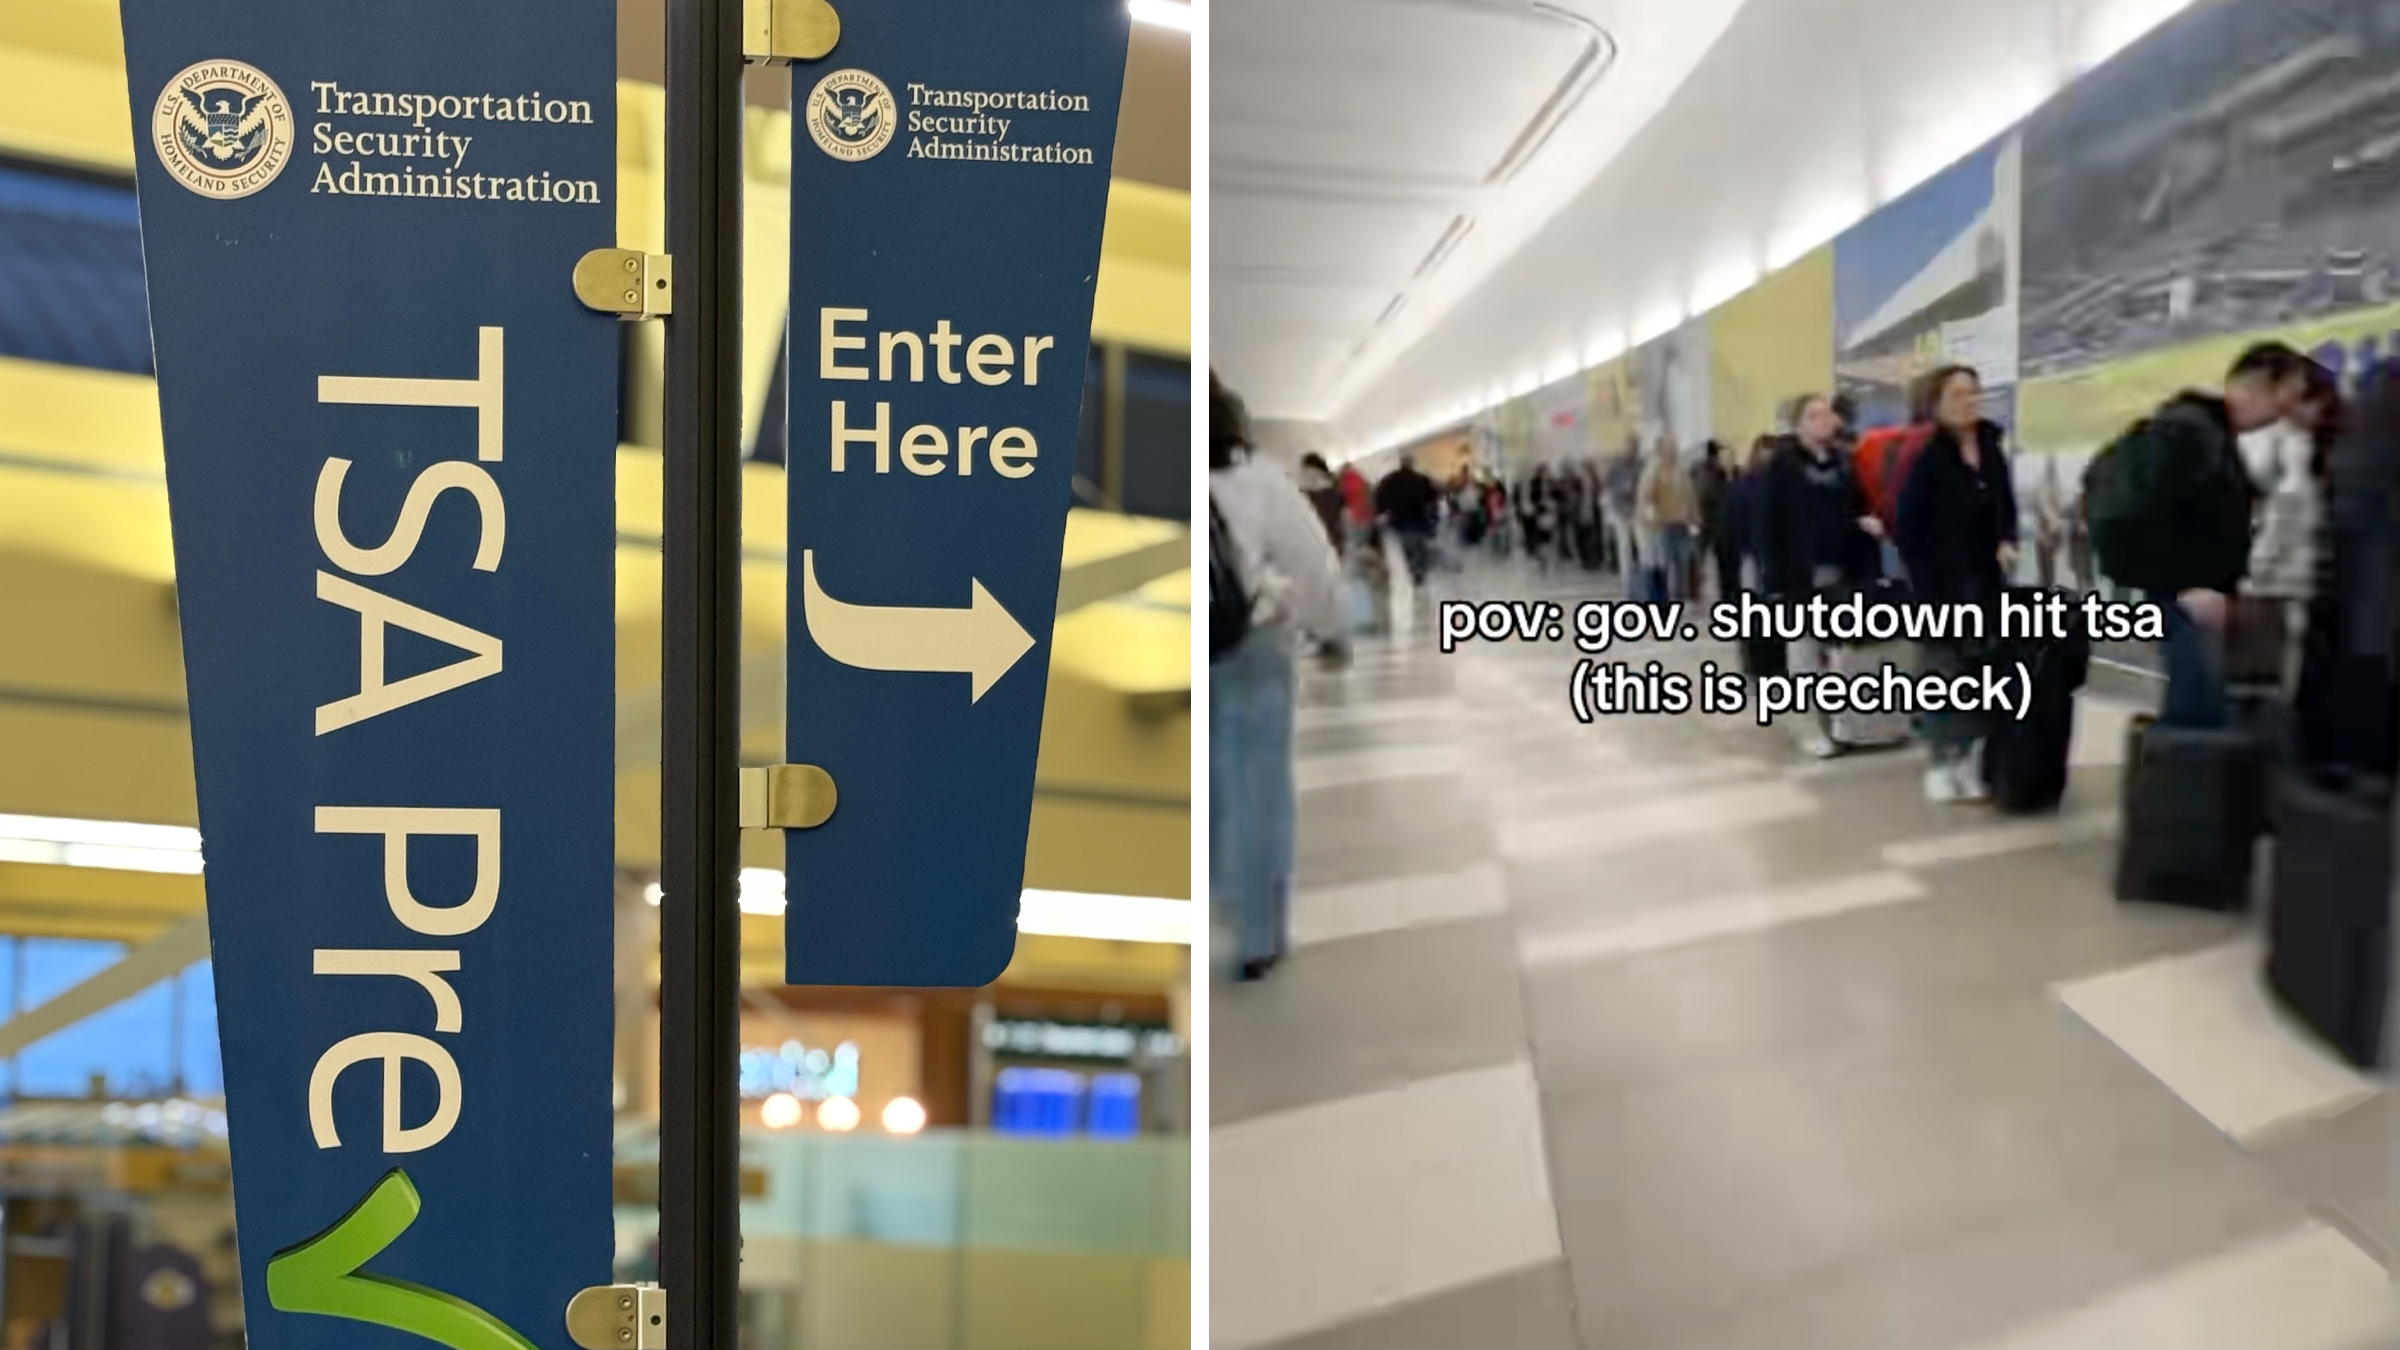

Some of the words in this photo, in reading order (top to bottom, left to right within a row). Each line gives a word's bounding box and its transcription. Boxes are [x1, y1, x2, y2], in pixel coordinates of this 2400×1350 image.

[161, 94, 181, 116] U.S.
[183, 66, 275, 102] DEPARTMENT
[271, 103, 286, 122] OF
[311, 80, 594, 127] Transportation
[826, 74, 886, 97] DEPARTMENT
[882, 98, 892, 111] OF
[907, 83, 1090, 114] Transportation
[313, 122, 473, 169] Security
[811, 118, 853, 157] HOMELAND
[857, 121, 892, 156] SECURITY
[908, 110, 1011, 142] Security
[161, 133, 226, 192] HOMELAND
[232, 138, 286, 191] SECURITY
[907, 136, 1094, 164] Administration
[310, 161, 601, 204] Administration
[820, 307, 1054, 386] Enter
[830, 401, 1039, 479] Here
[313, 326, 506, 737] TSA
[308, 806, 502, 1153] Pre
